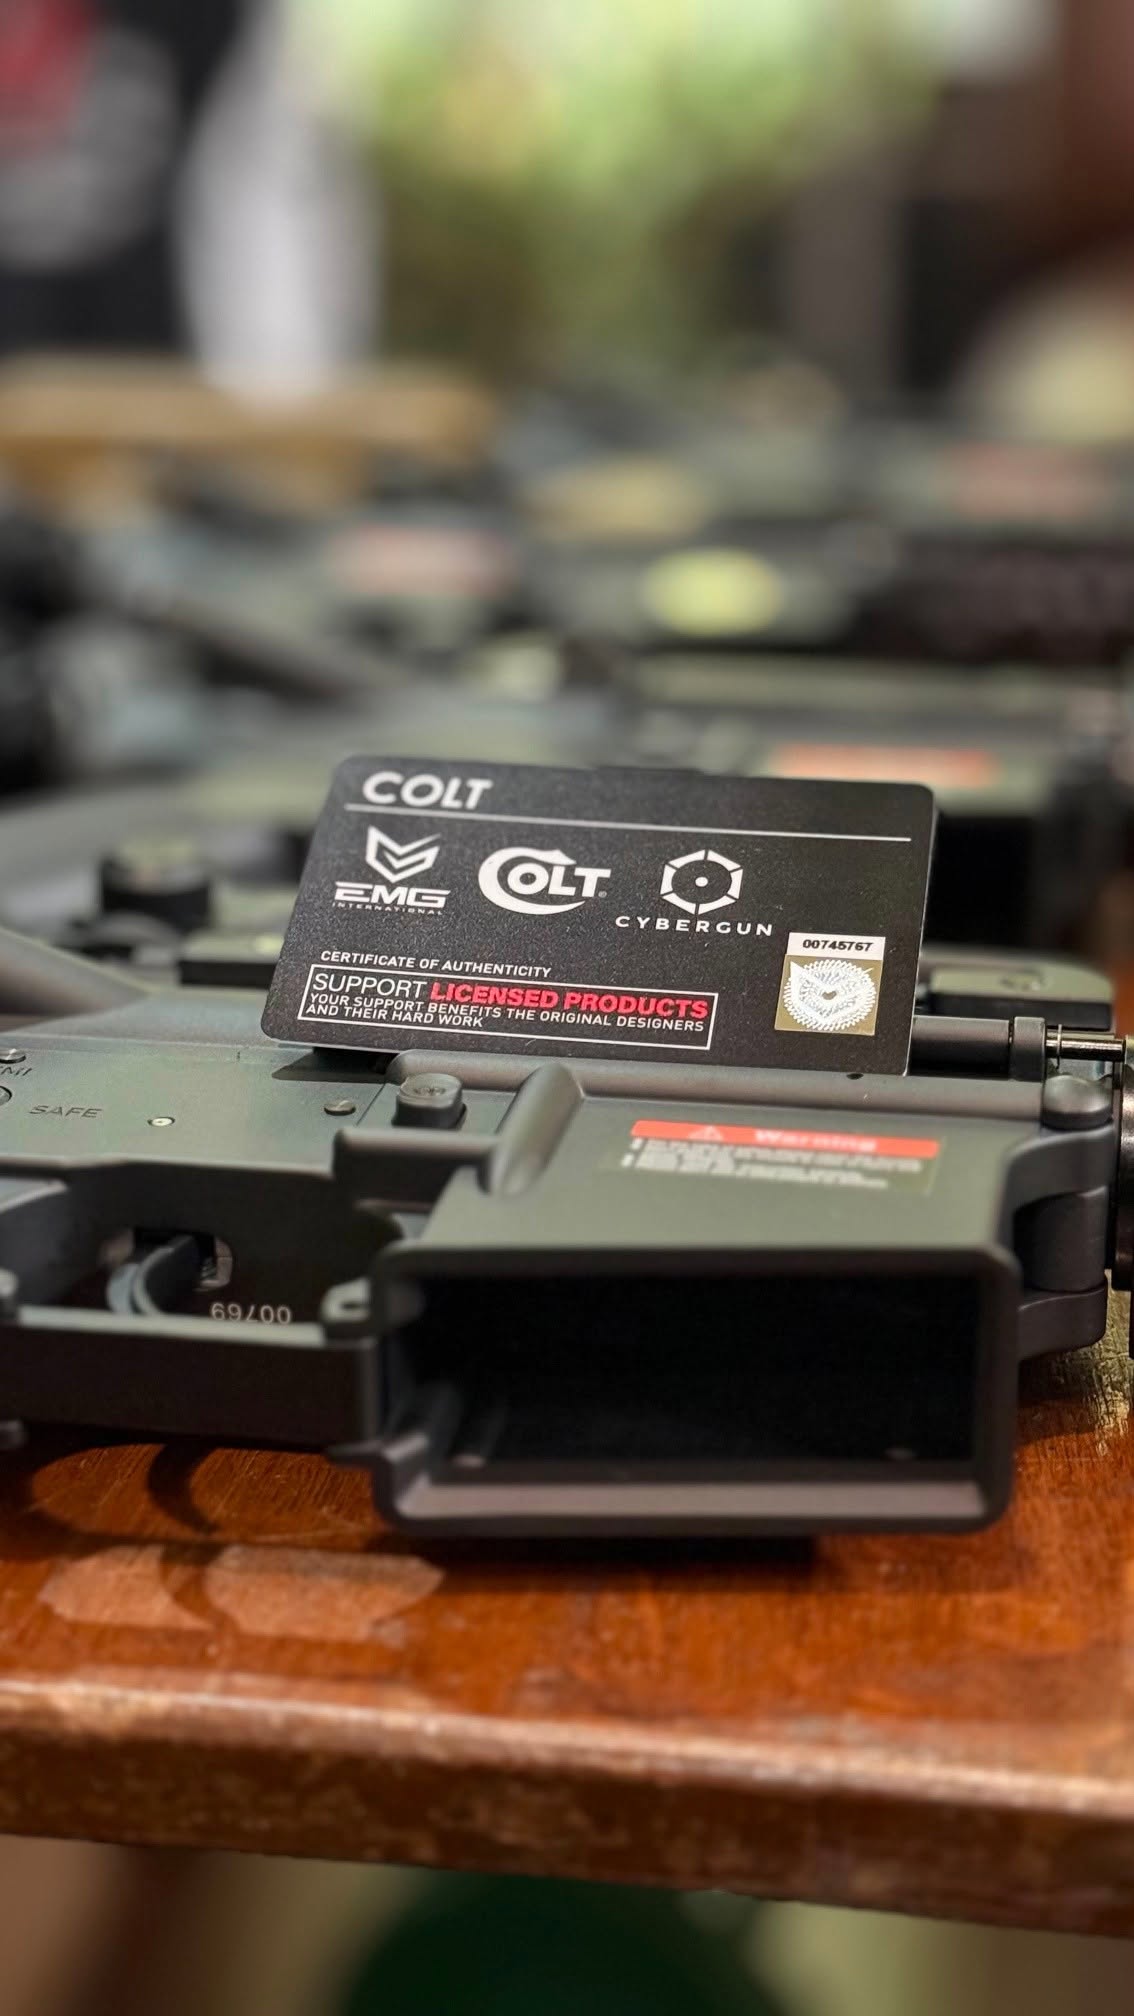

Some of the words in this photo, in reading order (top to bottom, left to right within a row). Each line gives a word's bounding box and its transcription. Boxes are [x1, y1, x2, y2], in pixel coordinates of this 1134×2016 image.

[362, 771, 493, 810] COLT
[334, 880, 451, 909] EMG
[332, 901, 443, 916] INTERNATIONAL
[615, 915, 773, 937] CYBERGUN
[802, 938, 874, 952] 00745767
[320, 950, 416, 968] CERTIFICATE
[419, 957, 439, 970] OF
[441, 961, 552, 978] AUTHENTICITY
[312, 972, 428, 998] SUPPORT
[430, 981, 559, 1010] LICENSED
[563, 991, 708, 1019] PRODUCTS
[305, 1003, 339, 1017] AND
[343, 1007, 389, 1020] THEIR
[391, 1011, 434, 1025] HARD
[437, 1015, 483, 1028] WORK
[309, 992, 350, 1007] YOUR
[353, 996, 424, 1012] SUPPORT
[427, 1001, 501, 1019] BENEFITS
[506, 1008, 535, 1021] THE
[539, 1010, 611, 1027] ORIGINAL
[616, 1016, 704, 1032] DESIGNERS
[29, 1104, 102, 1119] SAFE
